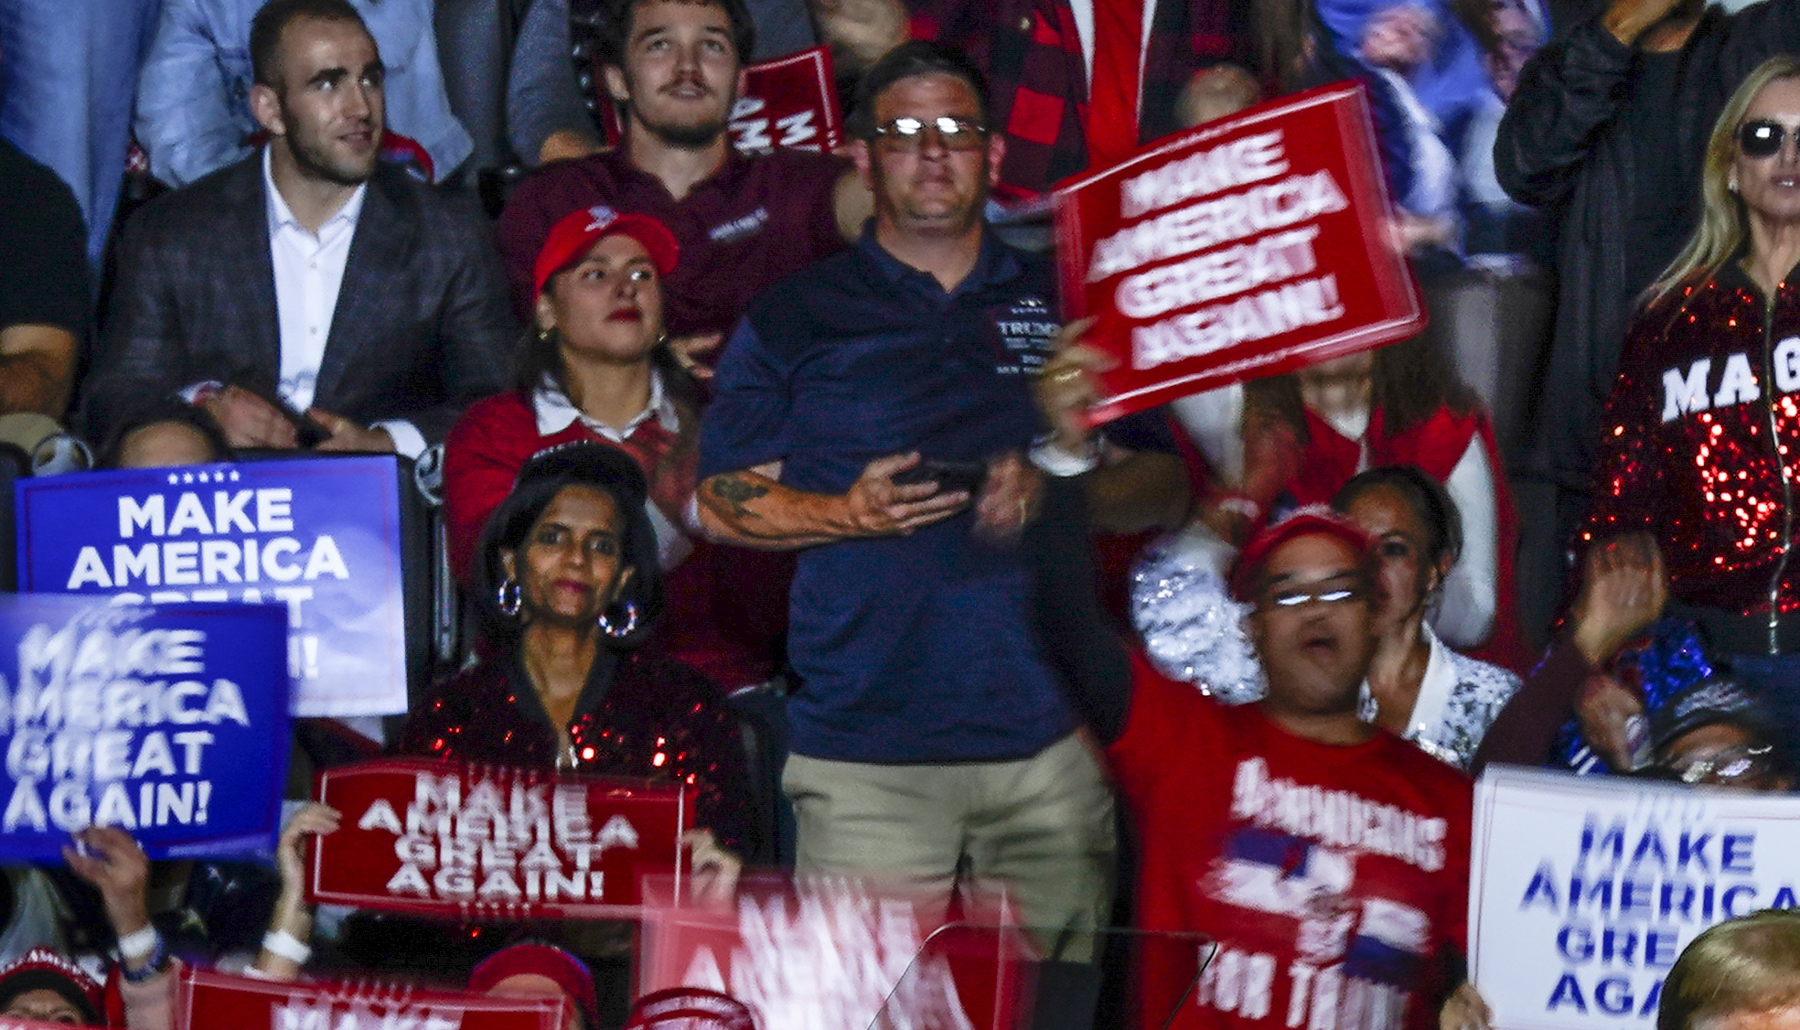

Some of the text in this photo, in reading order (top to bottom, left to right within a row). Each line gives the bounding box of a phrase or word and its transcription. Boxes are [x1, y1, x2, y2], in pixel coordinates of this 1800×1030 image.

[119, 489, 293, 537] MAKE
[67, 535, 349, 589] AMERICA
[18, 624, 205, 676] MAKE
[6, 731, 214, 780] GREAT
[3, 779, 212, 832] AGAIN!
[358, 800, 639, 851] AMERICA
[415, 771, 592, 830] MAKE
[395, 836, 602, 872] GREAT
[1579, 814, 1756, 876] MAKE
[387, 863, 604, 900] AGAIN!
[1519, 862, 1800, 922] AMERICA
[1556, 924, 1679, 968] GRE
[1546, 971, 1661, 1019] AGA
